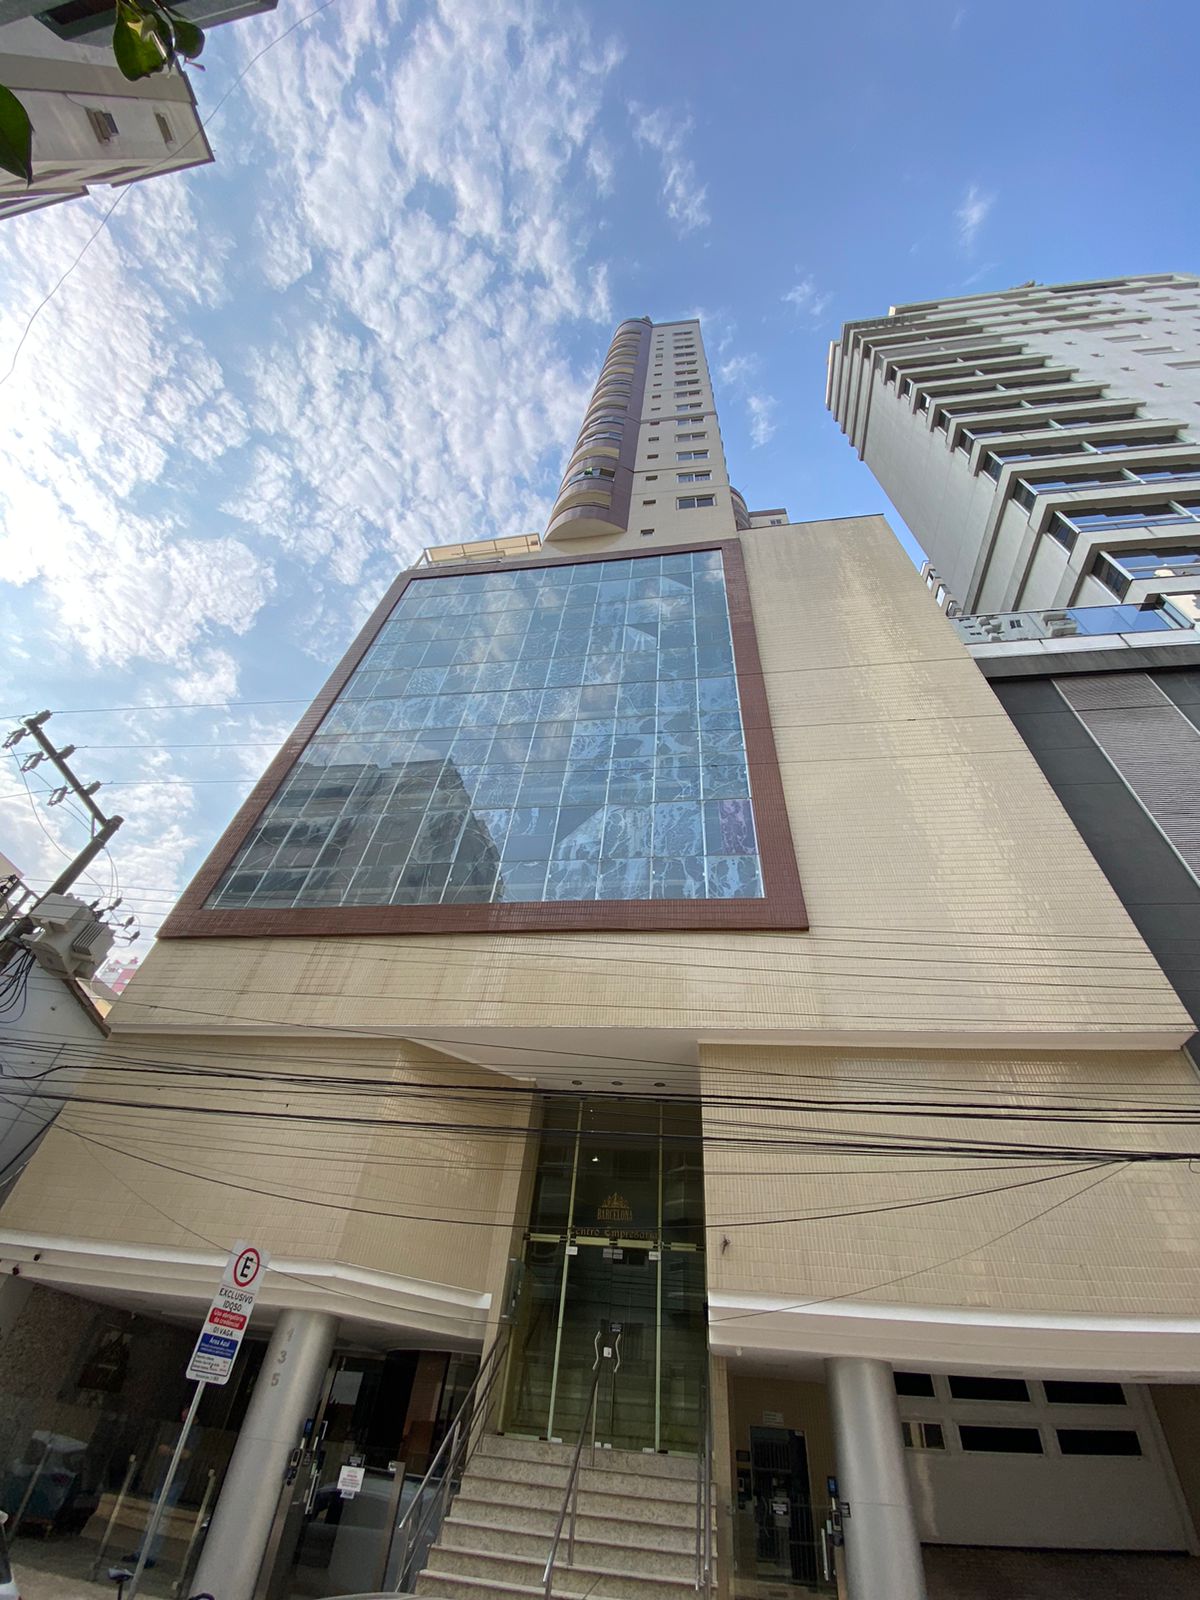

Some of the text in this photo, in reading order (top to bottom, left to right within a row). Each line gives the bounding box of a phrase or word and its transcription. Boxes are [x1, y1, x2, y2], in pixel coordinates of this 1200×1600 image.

[240, 1256, 254, 1278] E
[219, 1287, 253, 1304] EXCLUSIVO
[223, 1299, 242, 1311] IDOSO
[219, 1328, 233, 1336] VAGA
